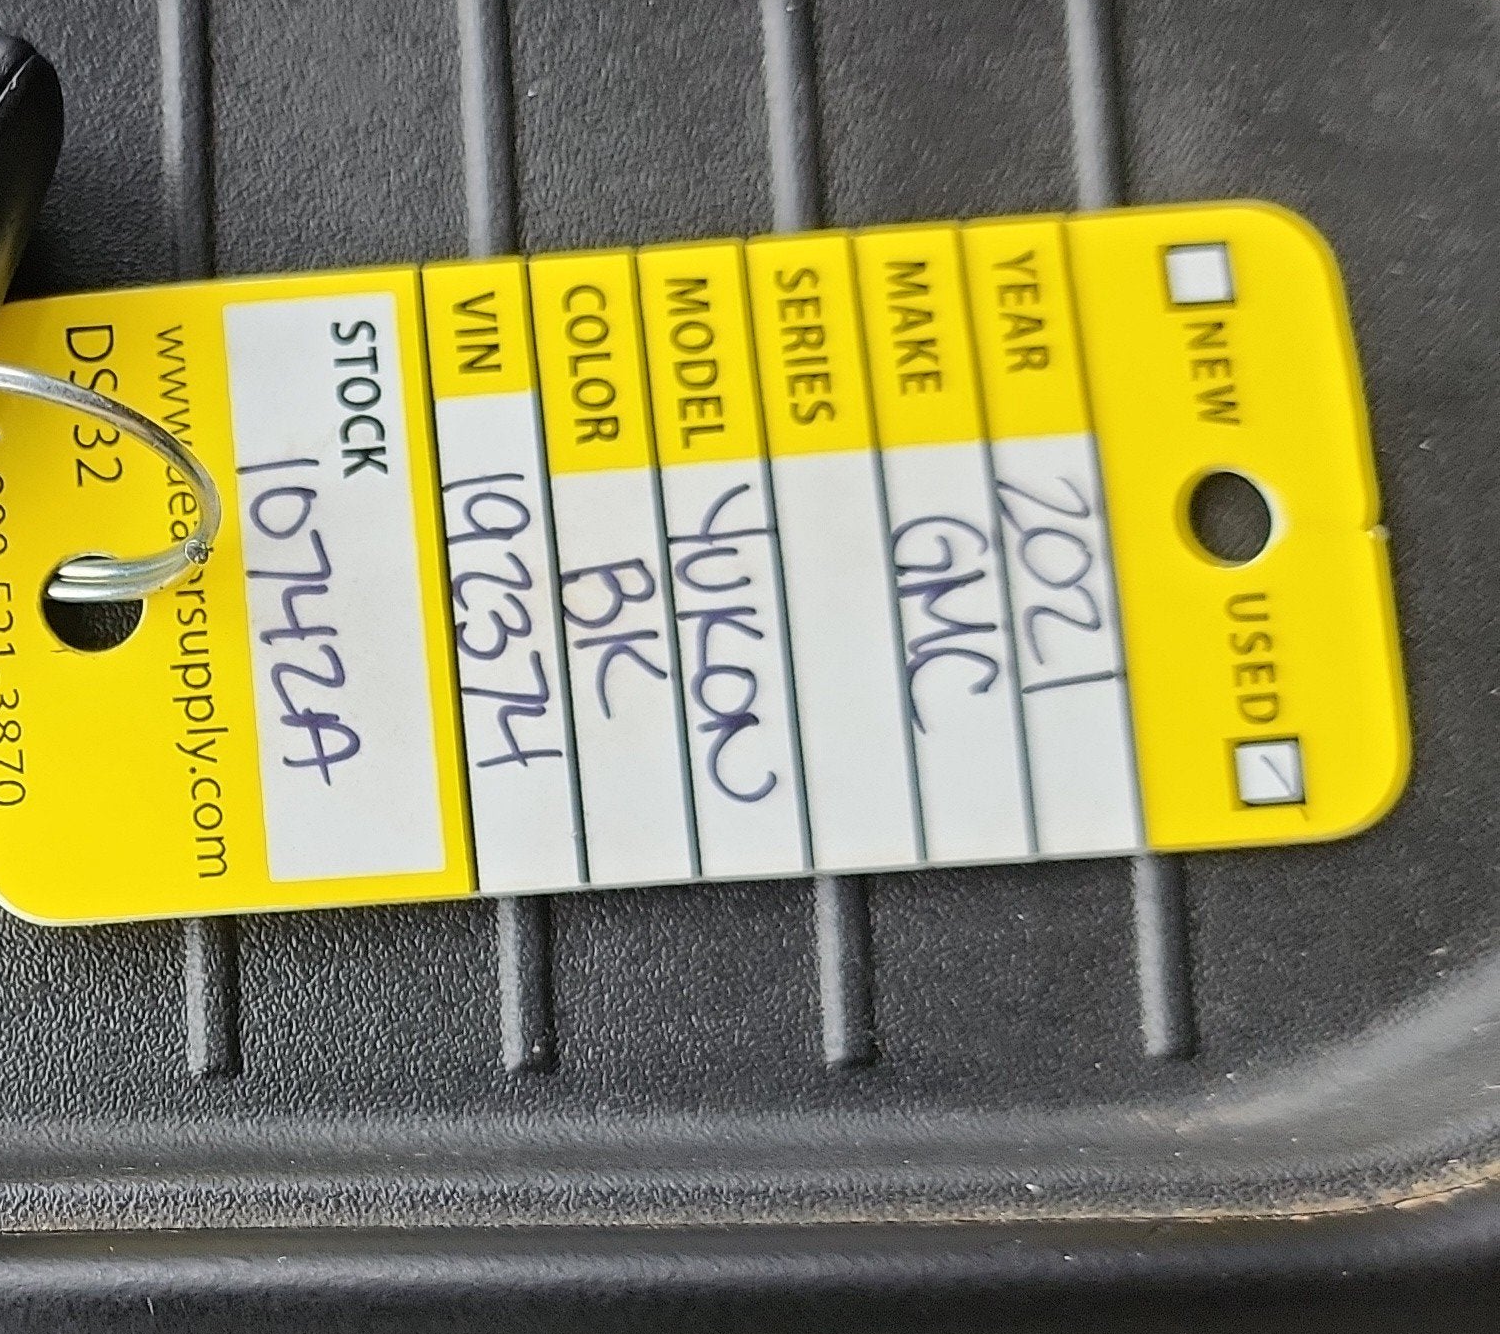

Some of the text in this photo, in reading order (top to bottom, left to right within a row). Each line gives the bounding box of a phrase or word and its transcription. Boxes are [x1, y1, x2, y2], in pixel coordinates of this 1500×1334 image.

[453, 290, 504, 375] VIN
[561, 283, 620, 446] COLOR
[663, 277, 725, 450] MODEL
[775, 269, 837, 426] SERIES
[883, 260, 943, 397] MAKE
[991, 248, 1050, 374] YEAR
[1184, 320, 1242, 427] NEW
[329, 320, 389, 479] STOCK
[153, 323, 231, 880] wwwearsupply.com
[236, 457, 362, 786] 10742A
[442, 472, 563, 769] 192374
[558, 556, 668, 721] BK
[891, 514, 999, 735] GMC
[995, 475, 1127, 694] 2021
[1222, 591, 1281, 726] USED
